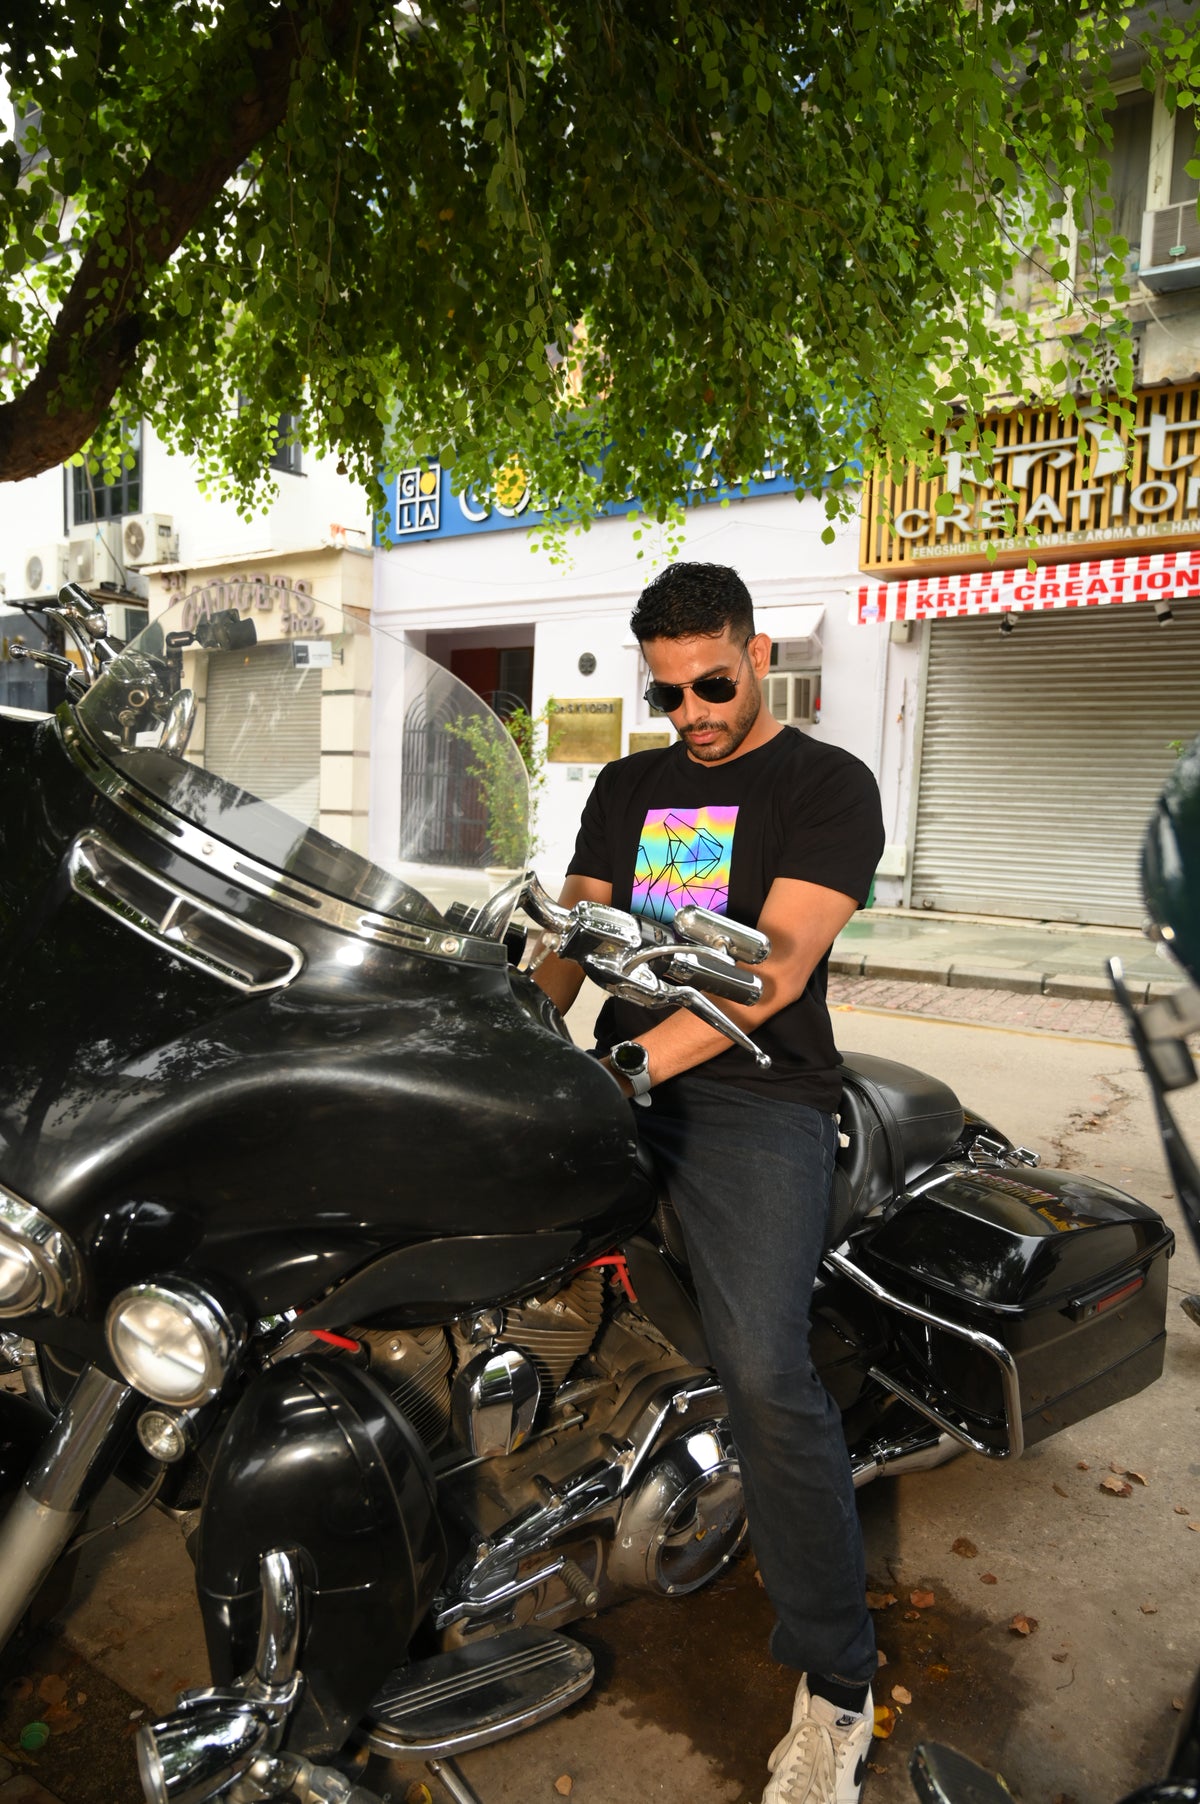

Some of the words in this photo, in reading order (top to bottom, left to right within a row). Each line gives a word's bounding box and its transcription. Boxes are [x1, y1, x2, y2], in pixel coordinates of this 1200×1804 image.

[912, 544, 969, 557] FENGSHUI
[980, 539, 1015, 552] GFTS
[1086, 526, 1132, 542] AROMA
[1137, 524, 1159, 537] OIL
[916, 587, 1000, 609] KRITI
[1013, 569, 1200, 600] CREATION
